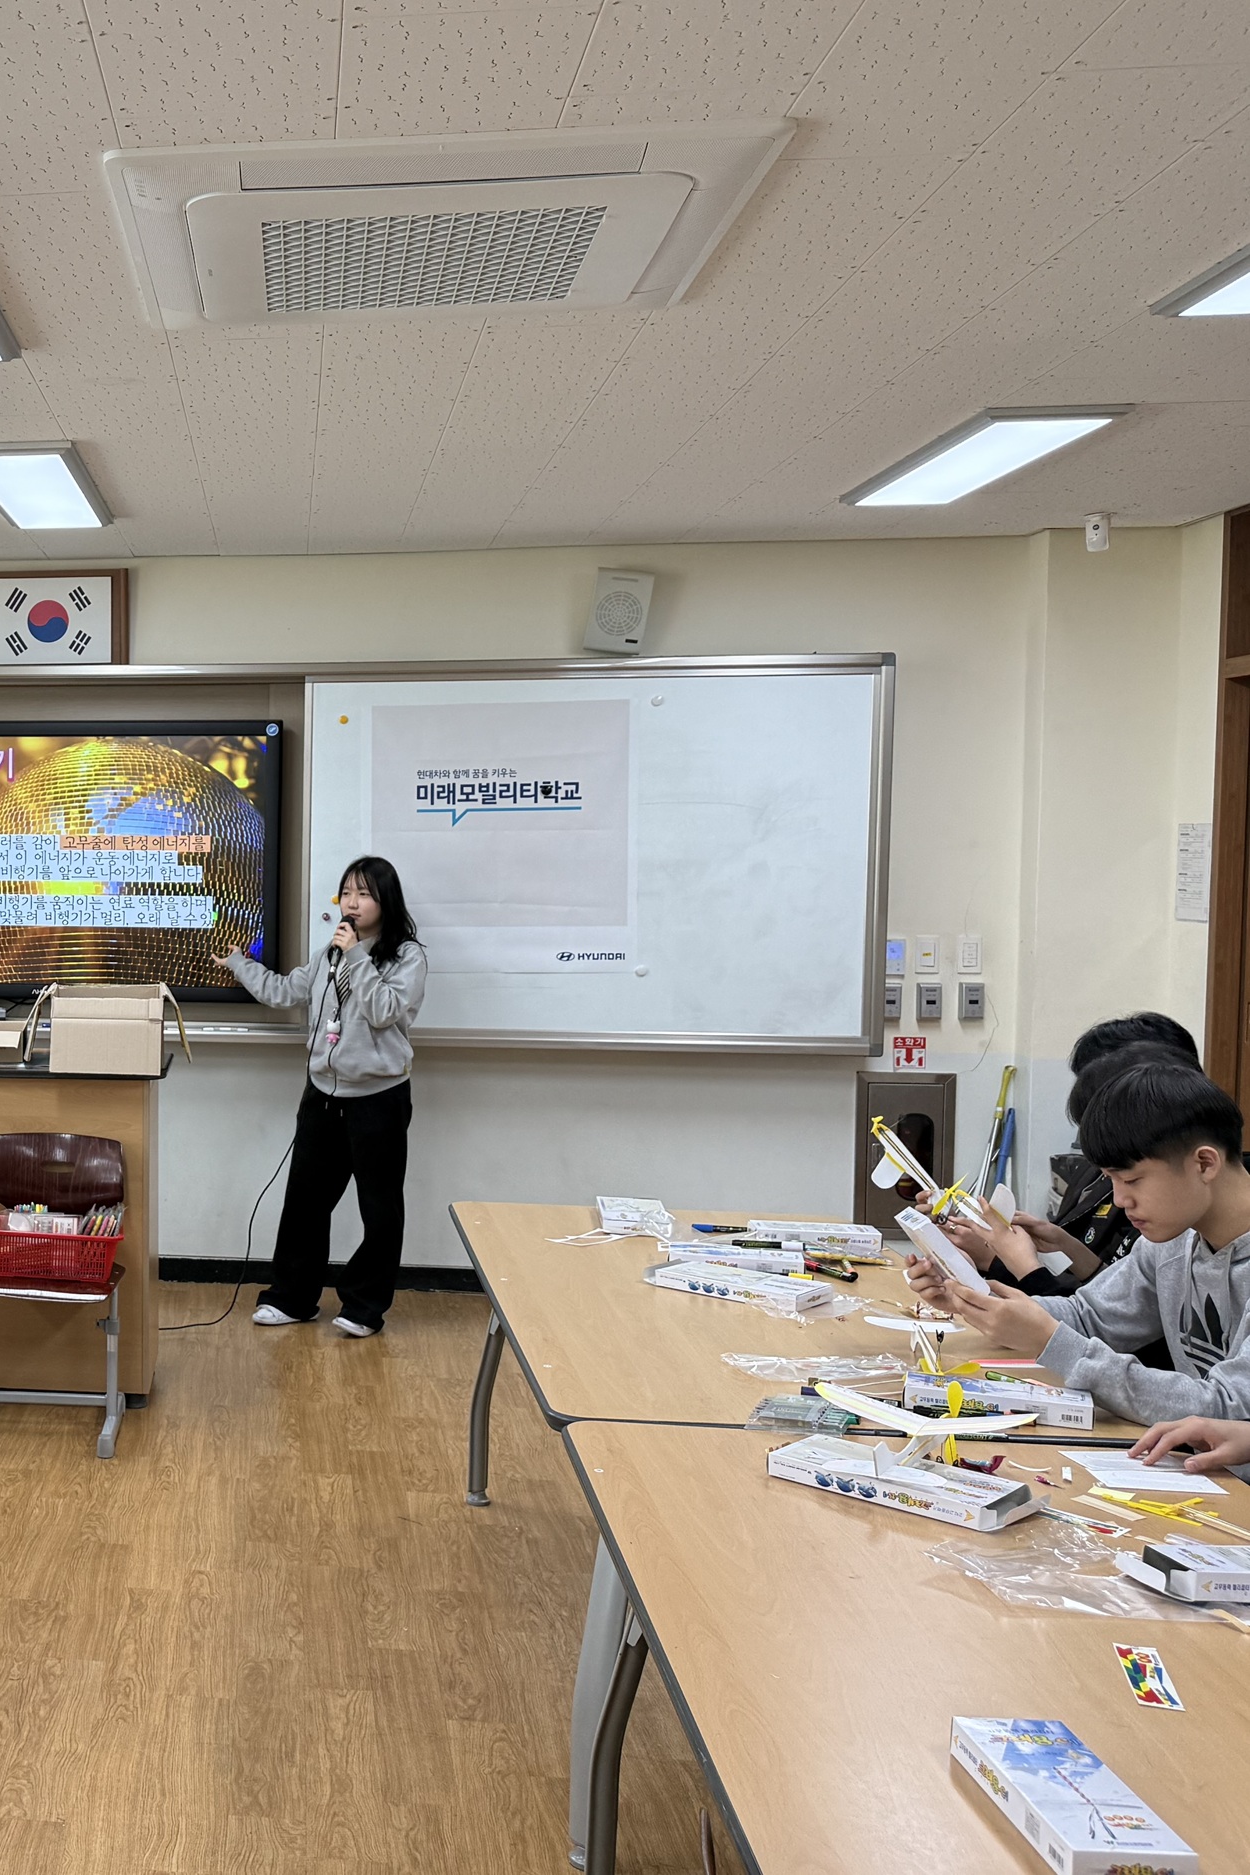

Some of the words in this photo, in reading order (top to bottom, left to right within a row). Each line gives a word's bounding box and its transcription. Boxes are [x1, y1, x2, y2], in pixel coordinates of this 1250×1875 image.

[417, 769, 450, 779] 현대차와
[453, 769, 470, 779] 함께
[472, 769, 490, 779] 꿈을
[491, 768, 517, 778] 키우는
[416, 780, 582, 806] 미래모빌리티학교
[32, 835, 58, 850] 감아
[63, 836, 116, 850] 고무줄에
[123, 836, 148, 850] 탄성
[152, 836, 207, 852] 에너지를
[15, 850, 27, 865] 이
[34, 851, 88, 866] 에너지가
[92, 851, 119, 866] 운동
[122, 851, 176, 866] 에너지로
[1, 865, 53, 880] 비행기를
[59, 866, 98, 880] 앞으로
[100, 866, 154, 881] 나아가게
[160, 866, 203, 881] 합니다.
[49, 895, 103, 911] 움직이는
[108, 896, 135, 911] 연료
[138, 896, 178, 912] 역할을
[0, 910, 38, 925] 맞물려
[45, 911, 97, 926] 비행기가
[134, 911, 161, 926] 오래
[167, 911, 180, 926] 날
[183, 912, 197, 926] 수
[200, 912, 214, 927] 있
[577, 952, 626, 961] HYUNDAI
[895, 1038, 924, 1047] 소화기
